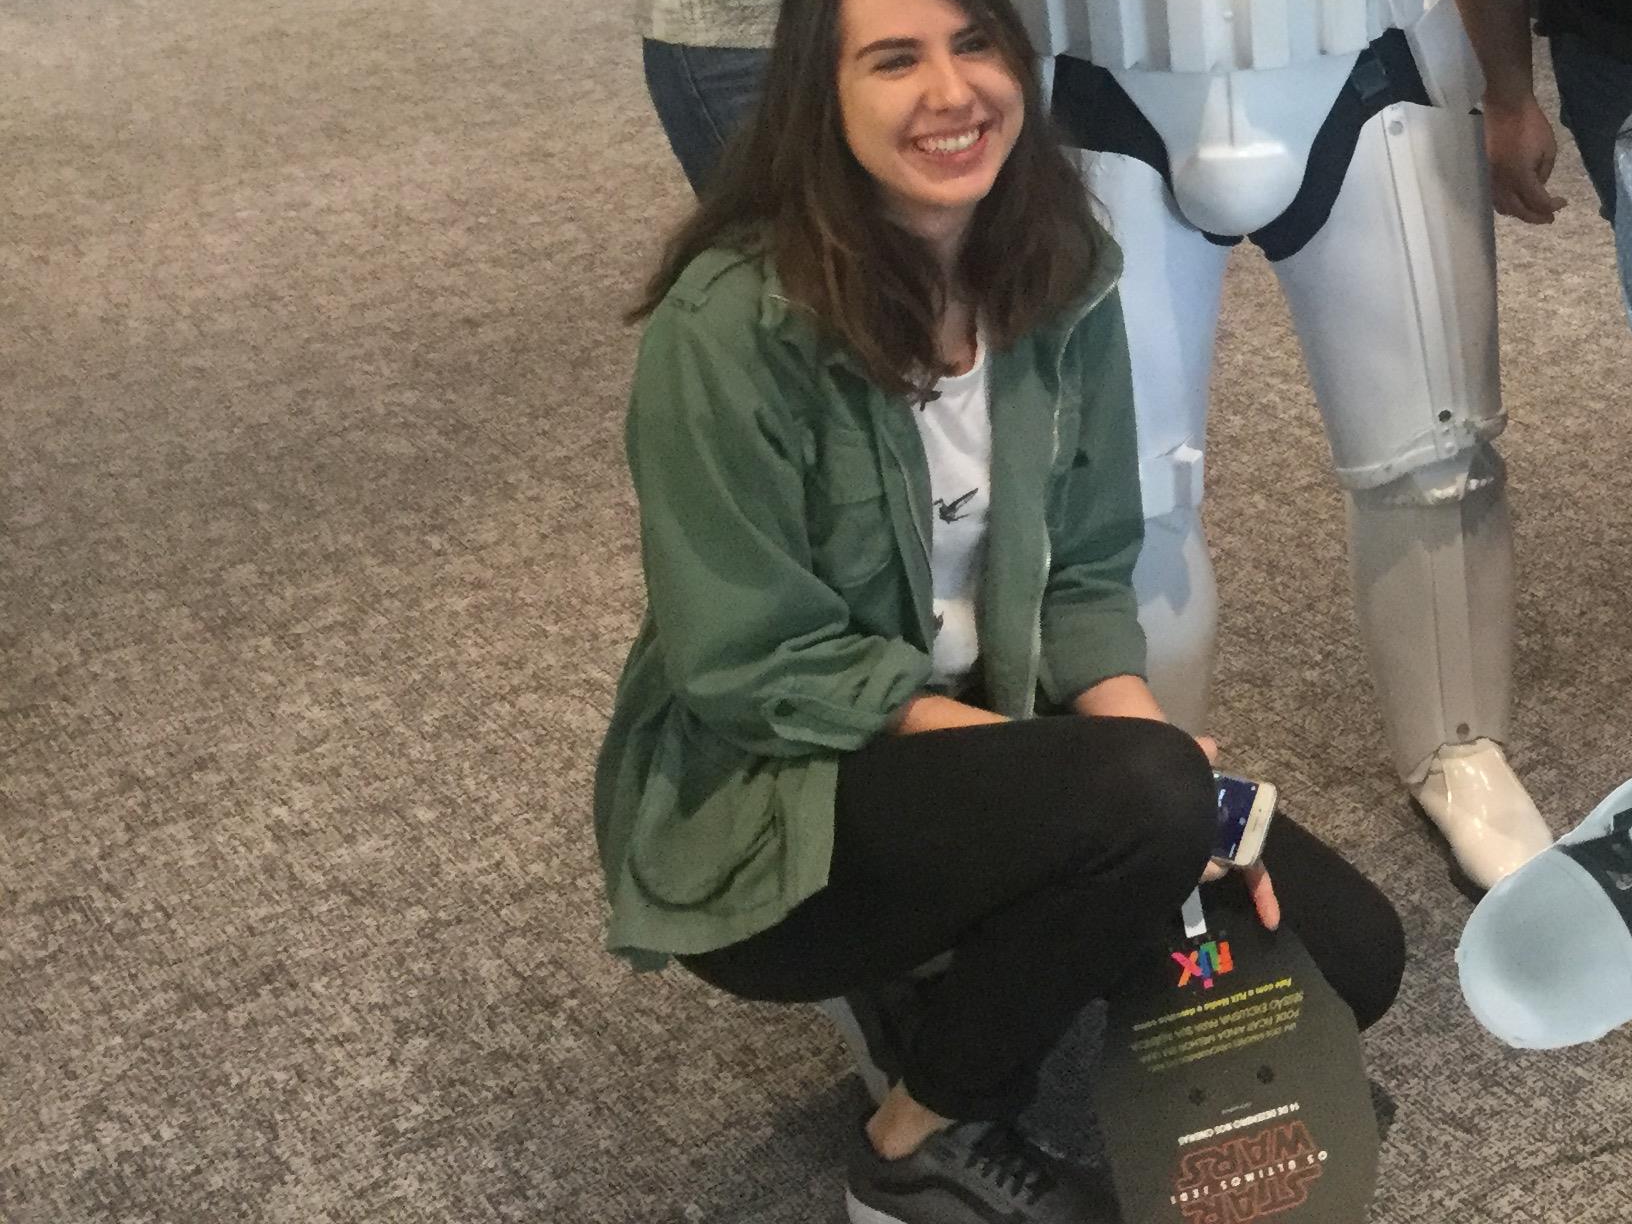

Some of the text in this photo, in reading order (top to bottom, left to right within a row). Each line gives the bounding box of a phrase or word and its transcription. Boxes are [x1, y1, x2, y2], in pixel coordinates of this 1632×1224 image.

[1176, 1120, 1317, 1191] WARS
[1307, 1150, 1328, 1165] OS
[1170, 1185, 1210, 1205] JEDI
[1180, 1163, 1323, 1224] STAR
